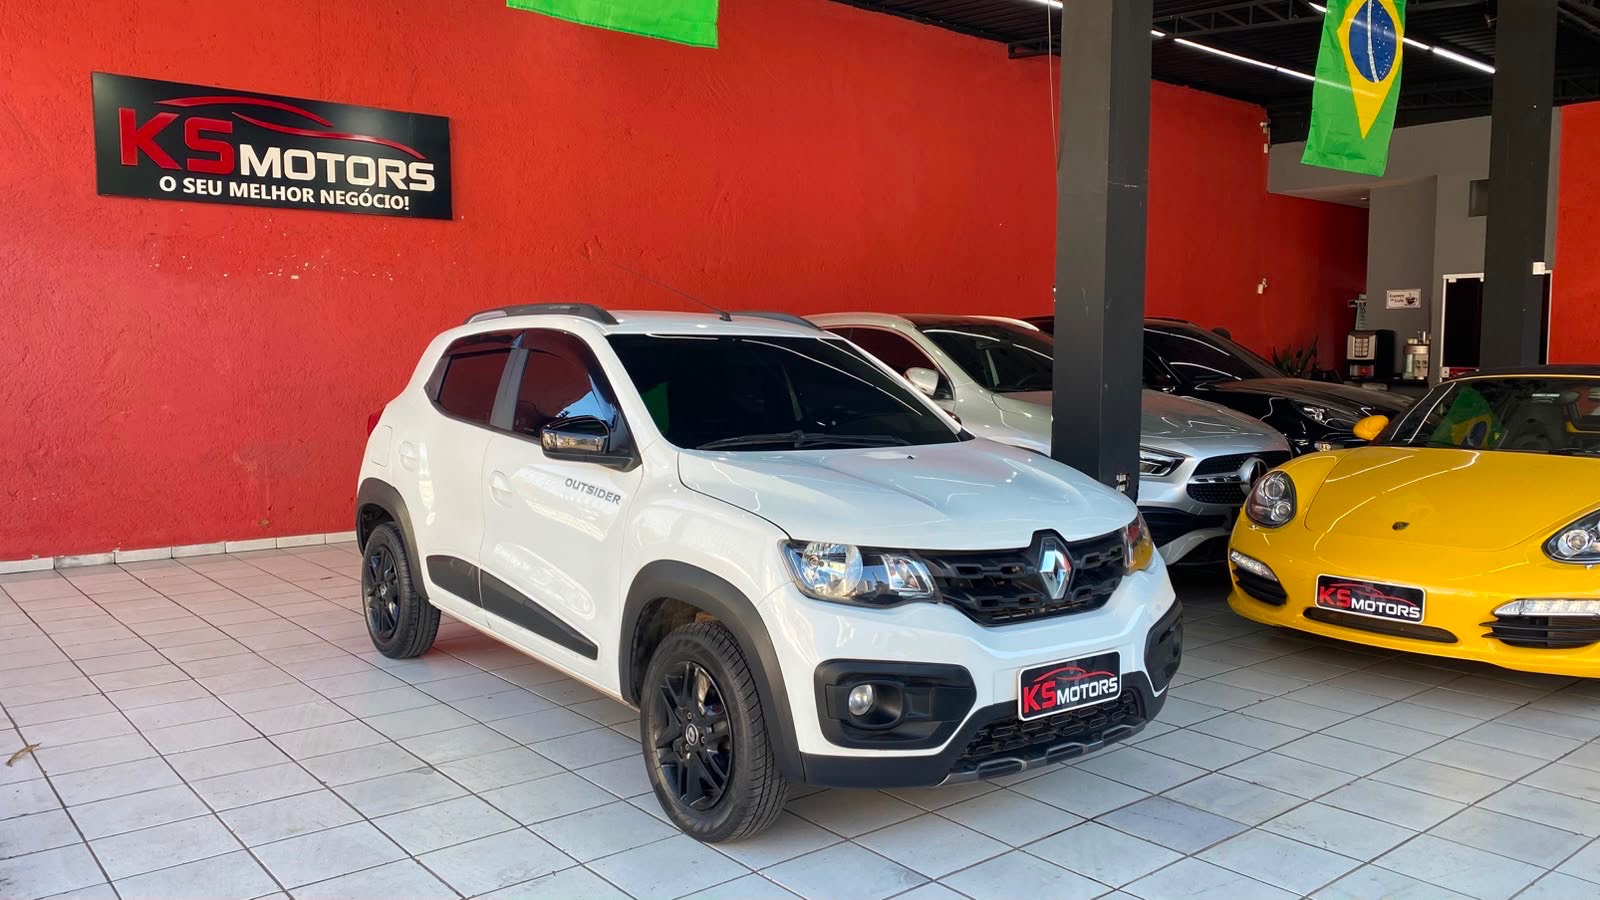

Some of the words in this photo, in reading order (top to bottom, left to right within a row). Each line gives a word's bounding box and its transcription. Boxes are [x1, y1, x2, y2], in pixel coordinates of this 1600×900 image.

[118, 107, 235, 175] KS
[239, 144, 436, 192] MOTORS
[159, 175, 177, 192] O
[183, 178, 223, 196] SEU
[229, 182, 315, 203] MELHOR
[320, 187, 410, 211] NEGÓCIO!
[565, 478, 621, 504] OUTSIDER
[1319, 586, 1351, 608] KS
[1351, 597, 1420, 619] MOTORS
[1023, 681, 1056, 714] KS
[1057, 676, 1118, 705] MOTORS
